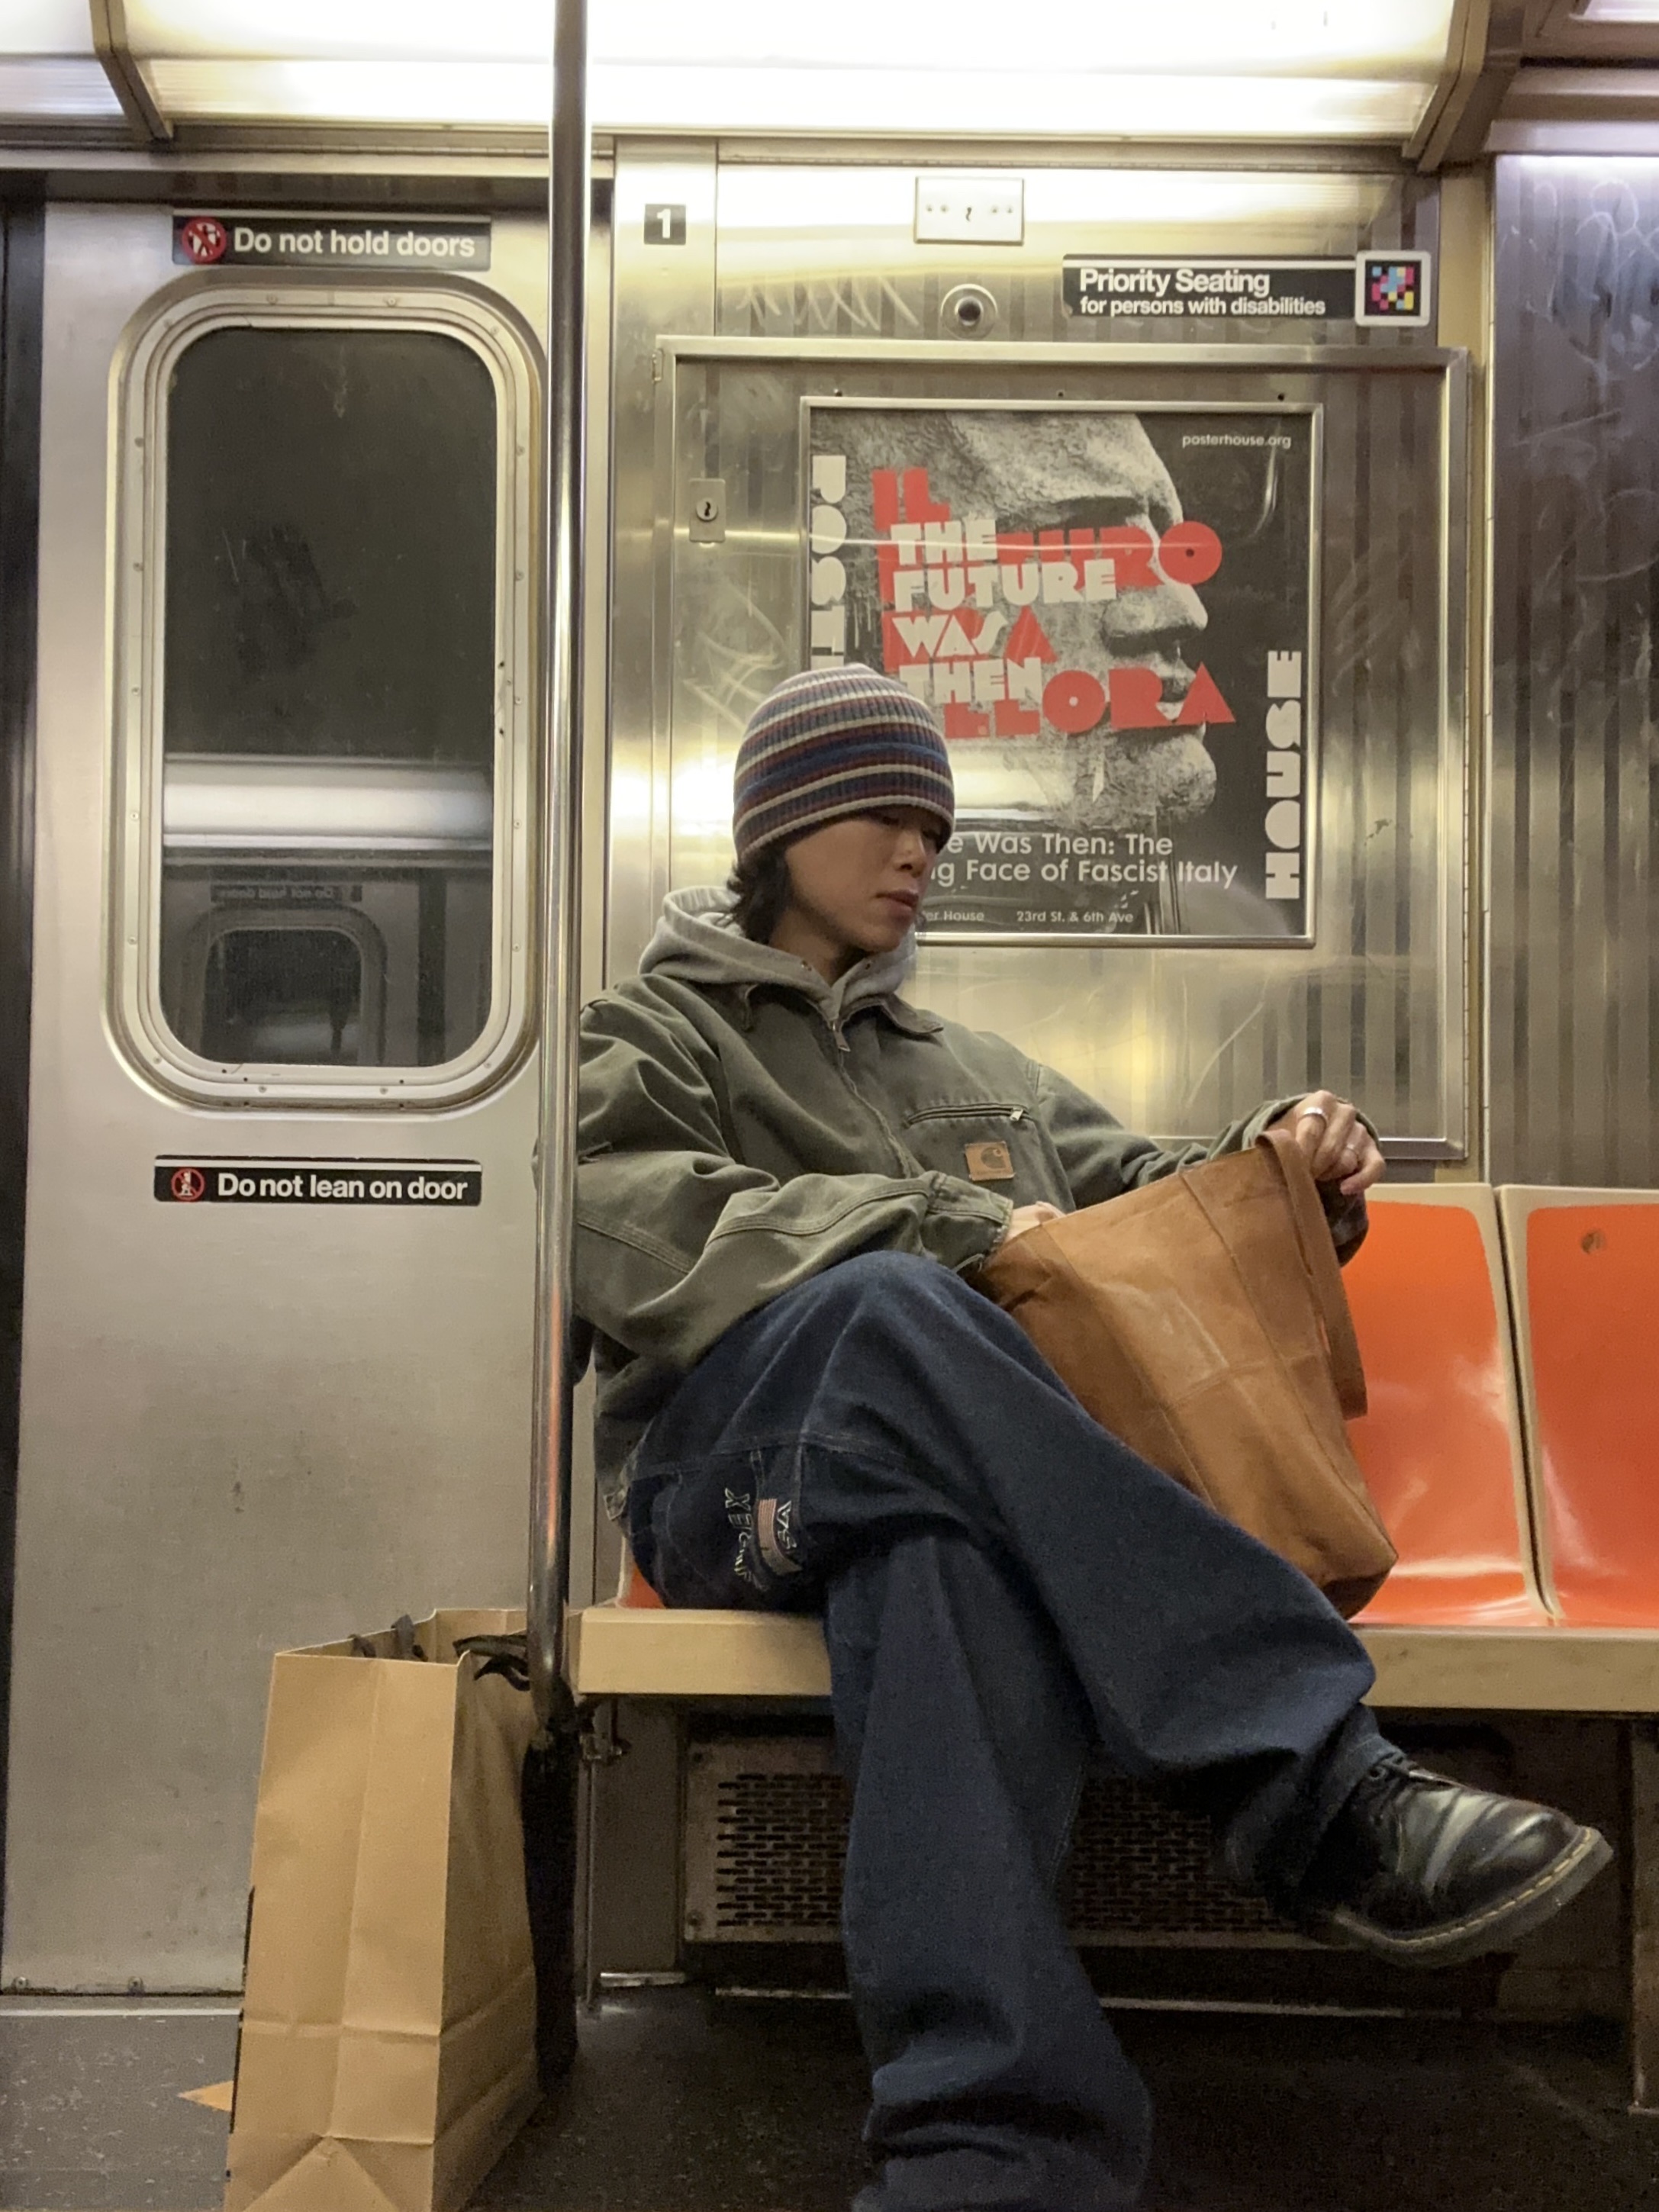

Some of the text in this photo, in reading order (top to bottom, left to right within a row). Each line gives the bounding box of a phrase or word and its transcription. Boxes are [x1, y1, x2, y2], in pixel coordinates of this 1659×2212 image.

[656, 208, 672, 238] 1
[234, 227, 475, 257] Do not hold doors
[1080, 269, 1270, 298] Priority Seating
[1080, 296, 1326, 317] for persons with disabilities
[1182, 433, 1291, 449] posterhouse.org
[891, 519, 997, 565] THE
[811, 455, 846, 671] POST
[894, 559, 1117, 613] FUTURE
[891, 610, 1008, 658] WAS
[899, 656, 1043, 704] THEN
[1264, 650, 1302, 900] HOUSE
[974, 832, 1032, 854] Was
[1042, 833, 1115, 855] Then:
[1125, 833, 1173, 855] The
[966, 859, 1031, 881] Face
[1040, 858, 1069, 881] of
[1078, 859, 1168, 882] Fascist
[1178, 861, 1238, 890] Italy
[944, 910, 984, 922] House
[1016, 910, 1046, 922] 23rd
[1050, 910, 1066, 922] St.
[1069, 911, 1079, 922] &
[1083, 911, 1104, 923] 6th
[1108, 912, 1134, 923] Ave
[217, 1172, 468, 1199] Do not lean on door
